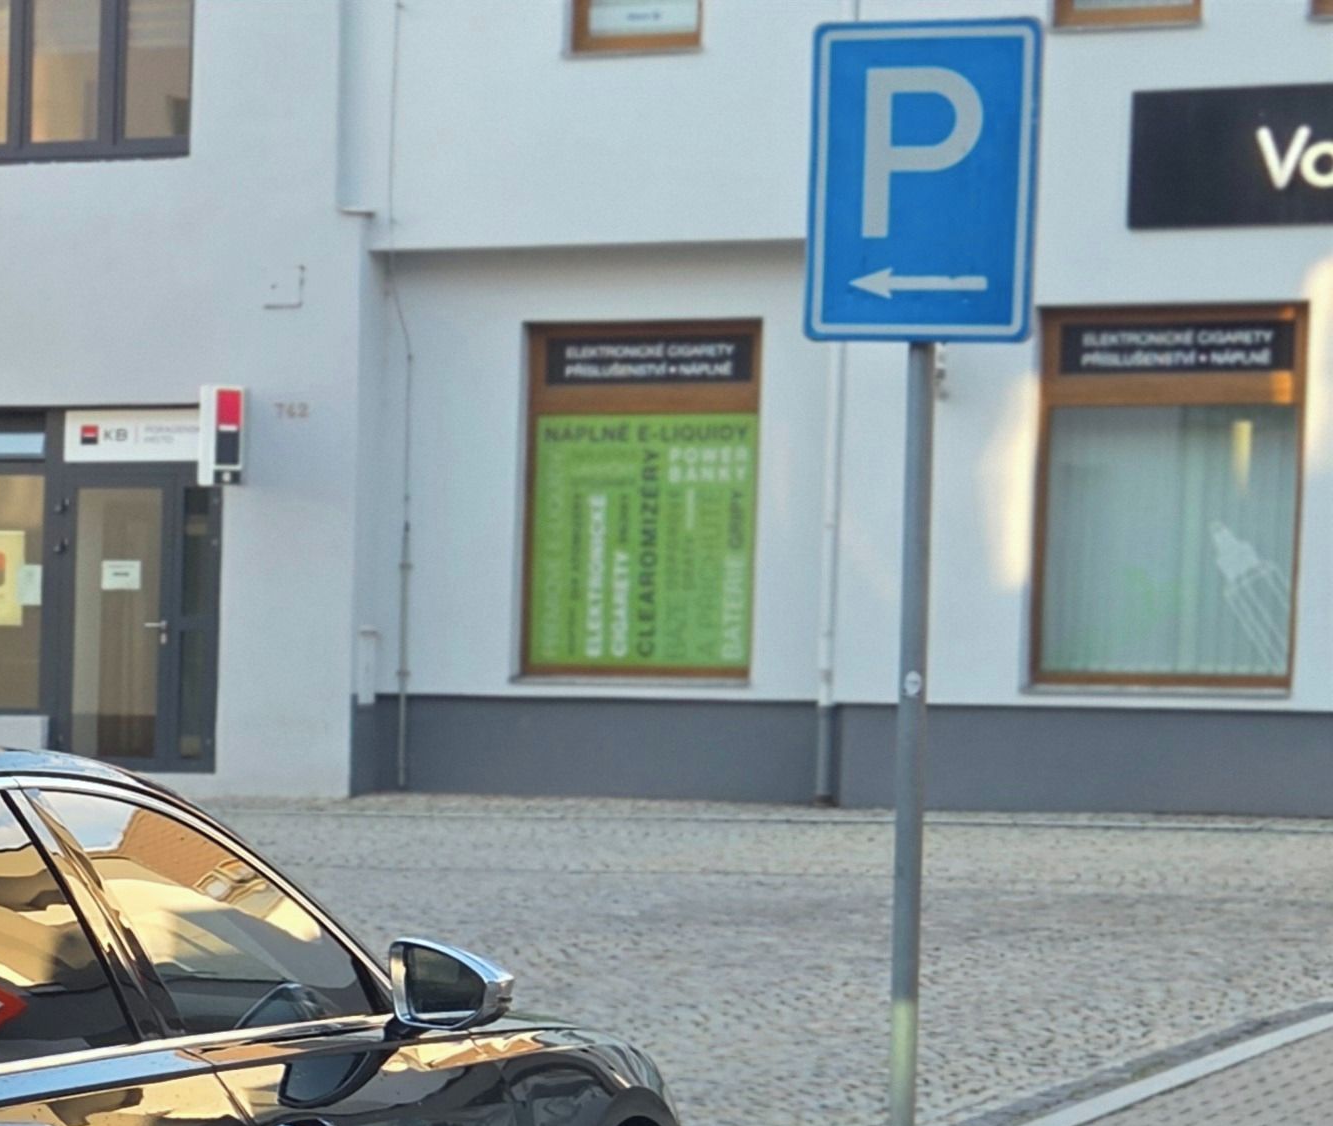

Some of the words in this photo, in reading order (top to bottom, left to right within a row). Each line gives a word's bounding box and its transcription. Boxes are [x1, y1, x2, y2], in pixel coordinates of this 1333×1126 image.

[861, 66, 983, 238] P
[1197, 329, 1273, 345] CIGARETY
[667, 342, 735, 358] CIGARETY
[103, 428, 128, 442] KB
[668, 445, 748, 464] POWER
[667, 464, 747, 484] BANKY
[610, 550, 630, 658] CIGARETY
